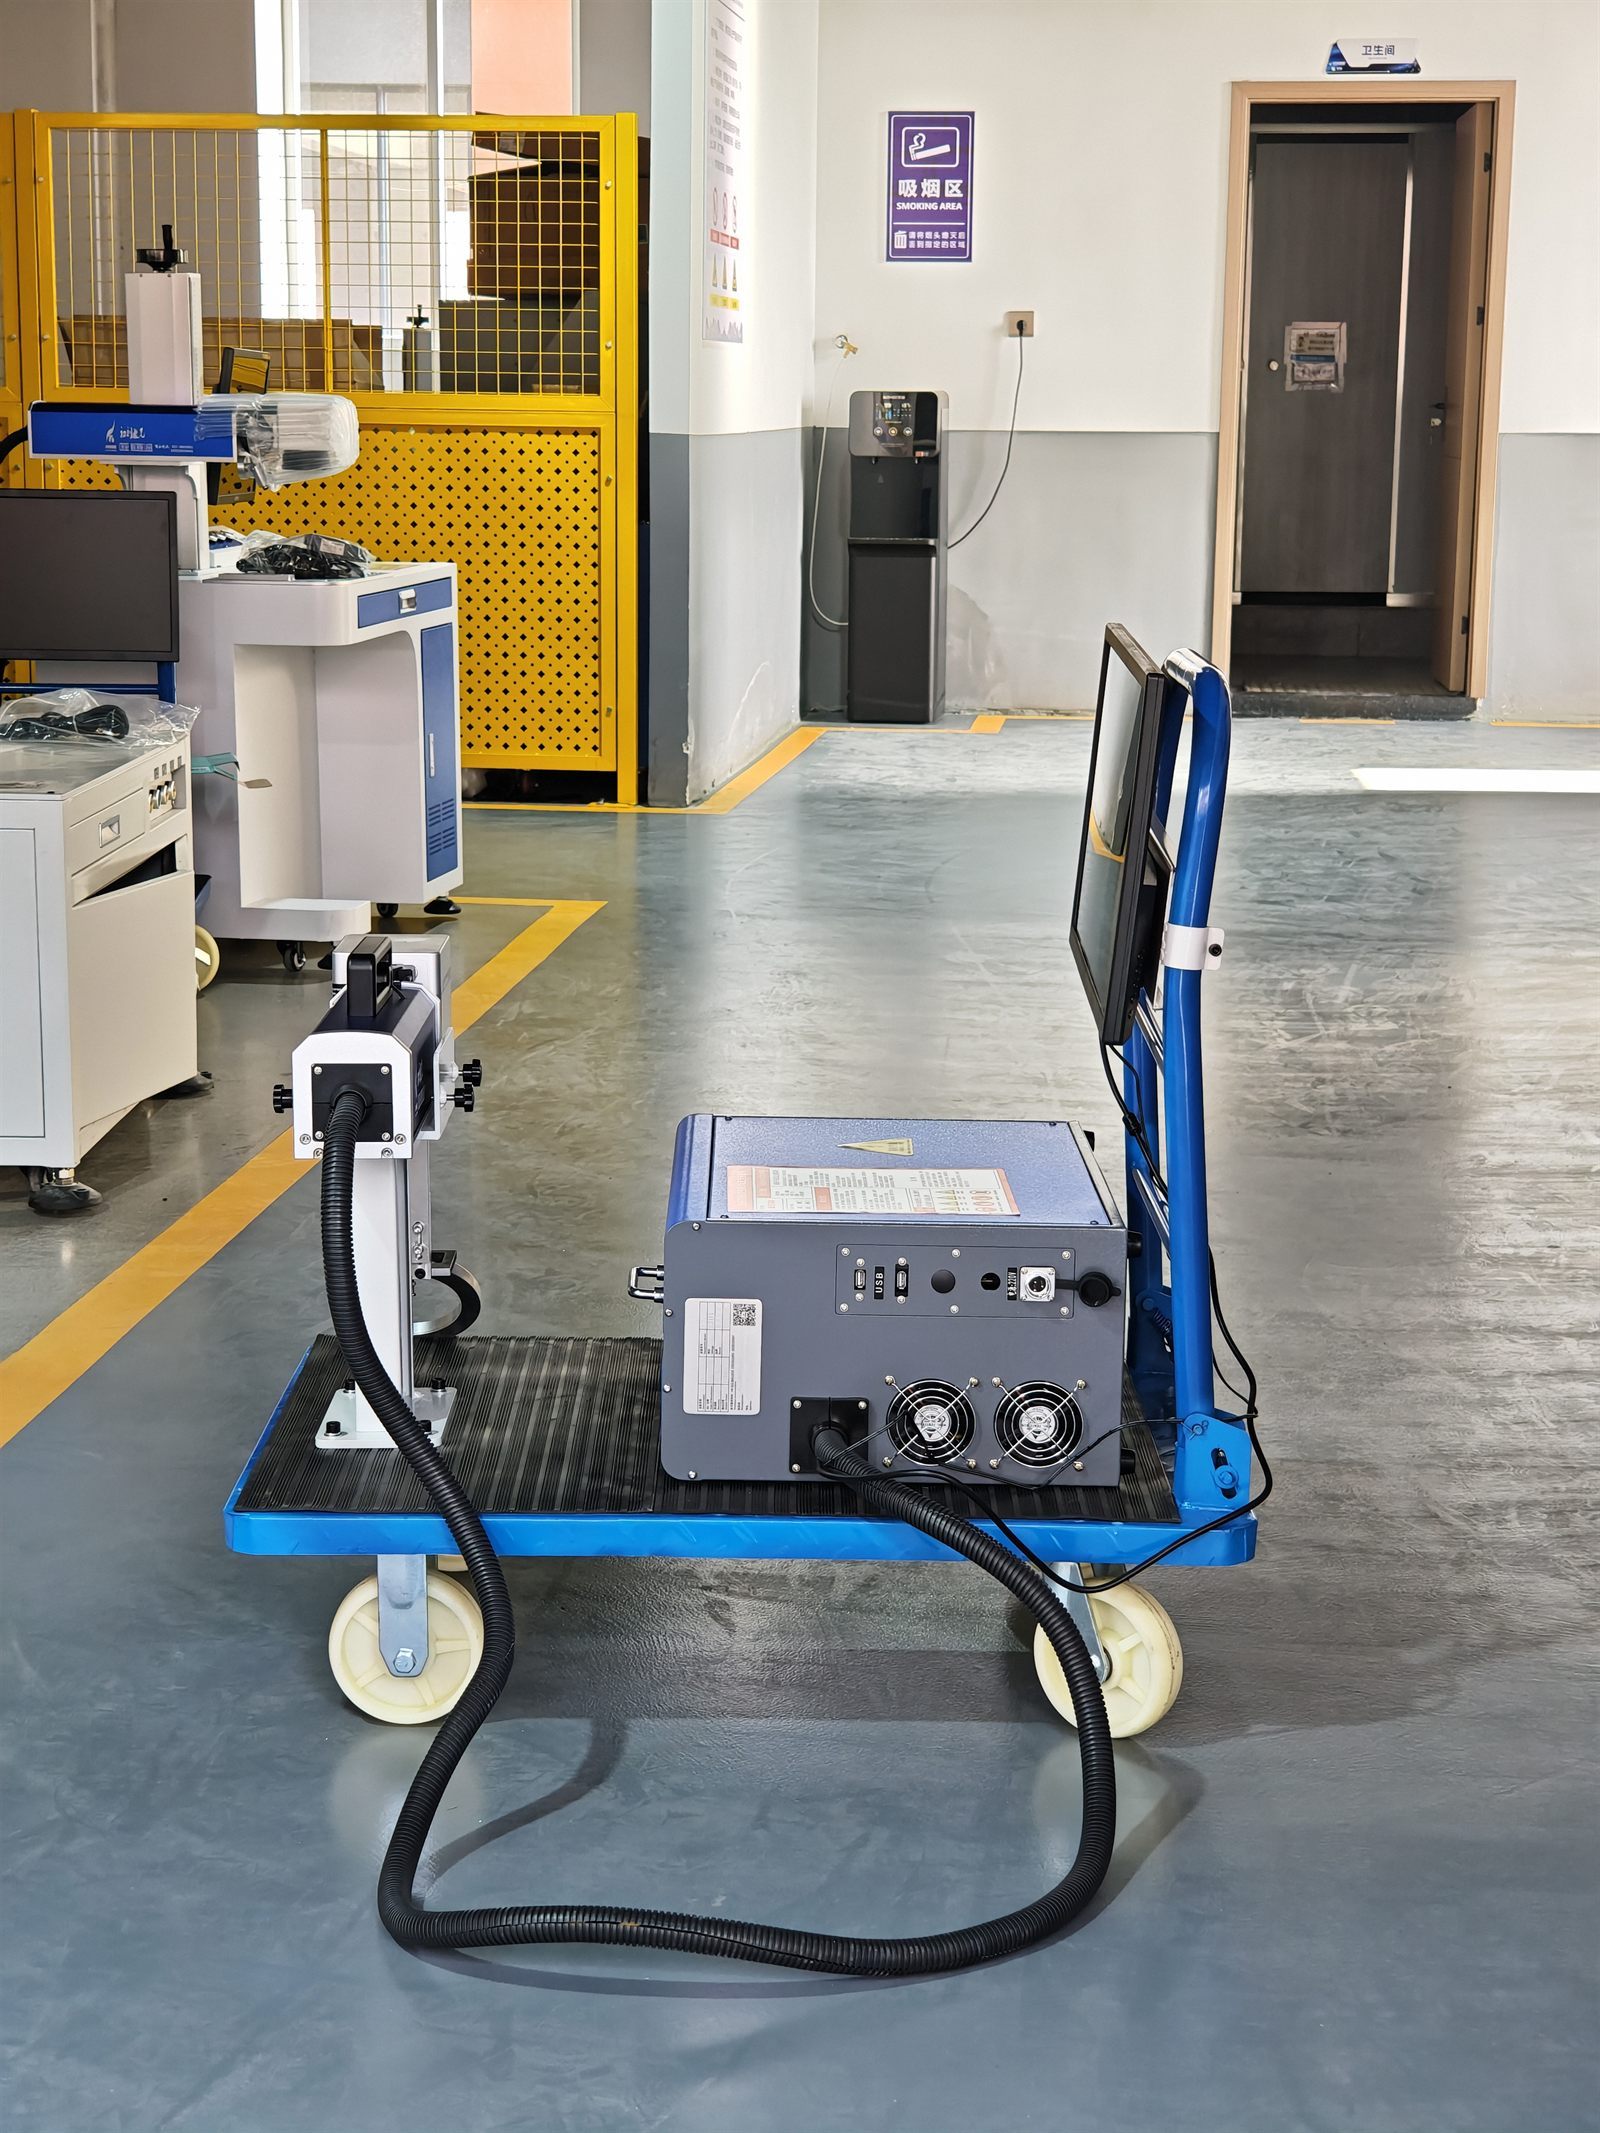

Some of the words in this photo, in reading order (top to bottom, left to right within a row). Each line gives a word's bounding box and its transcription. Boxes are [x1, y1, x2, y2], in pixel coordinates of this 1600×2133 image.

[1361, 45, 1395, 56] 卫生间
[898, 179, 963, 198] 吸烟区
[896, 202, 938, 210] SMOKING
[939, 202, 963, 210] AREA
[875, 1272, 884, 1293] USB
